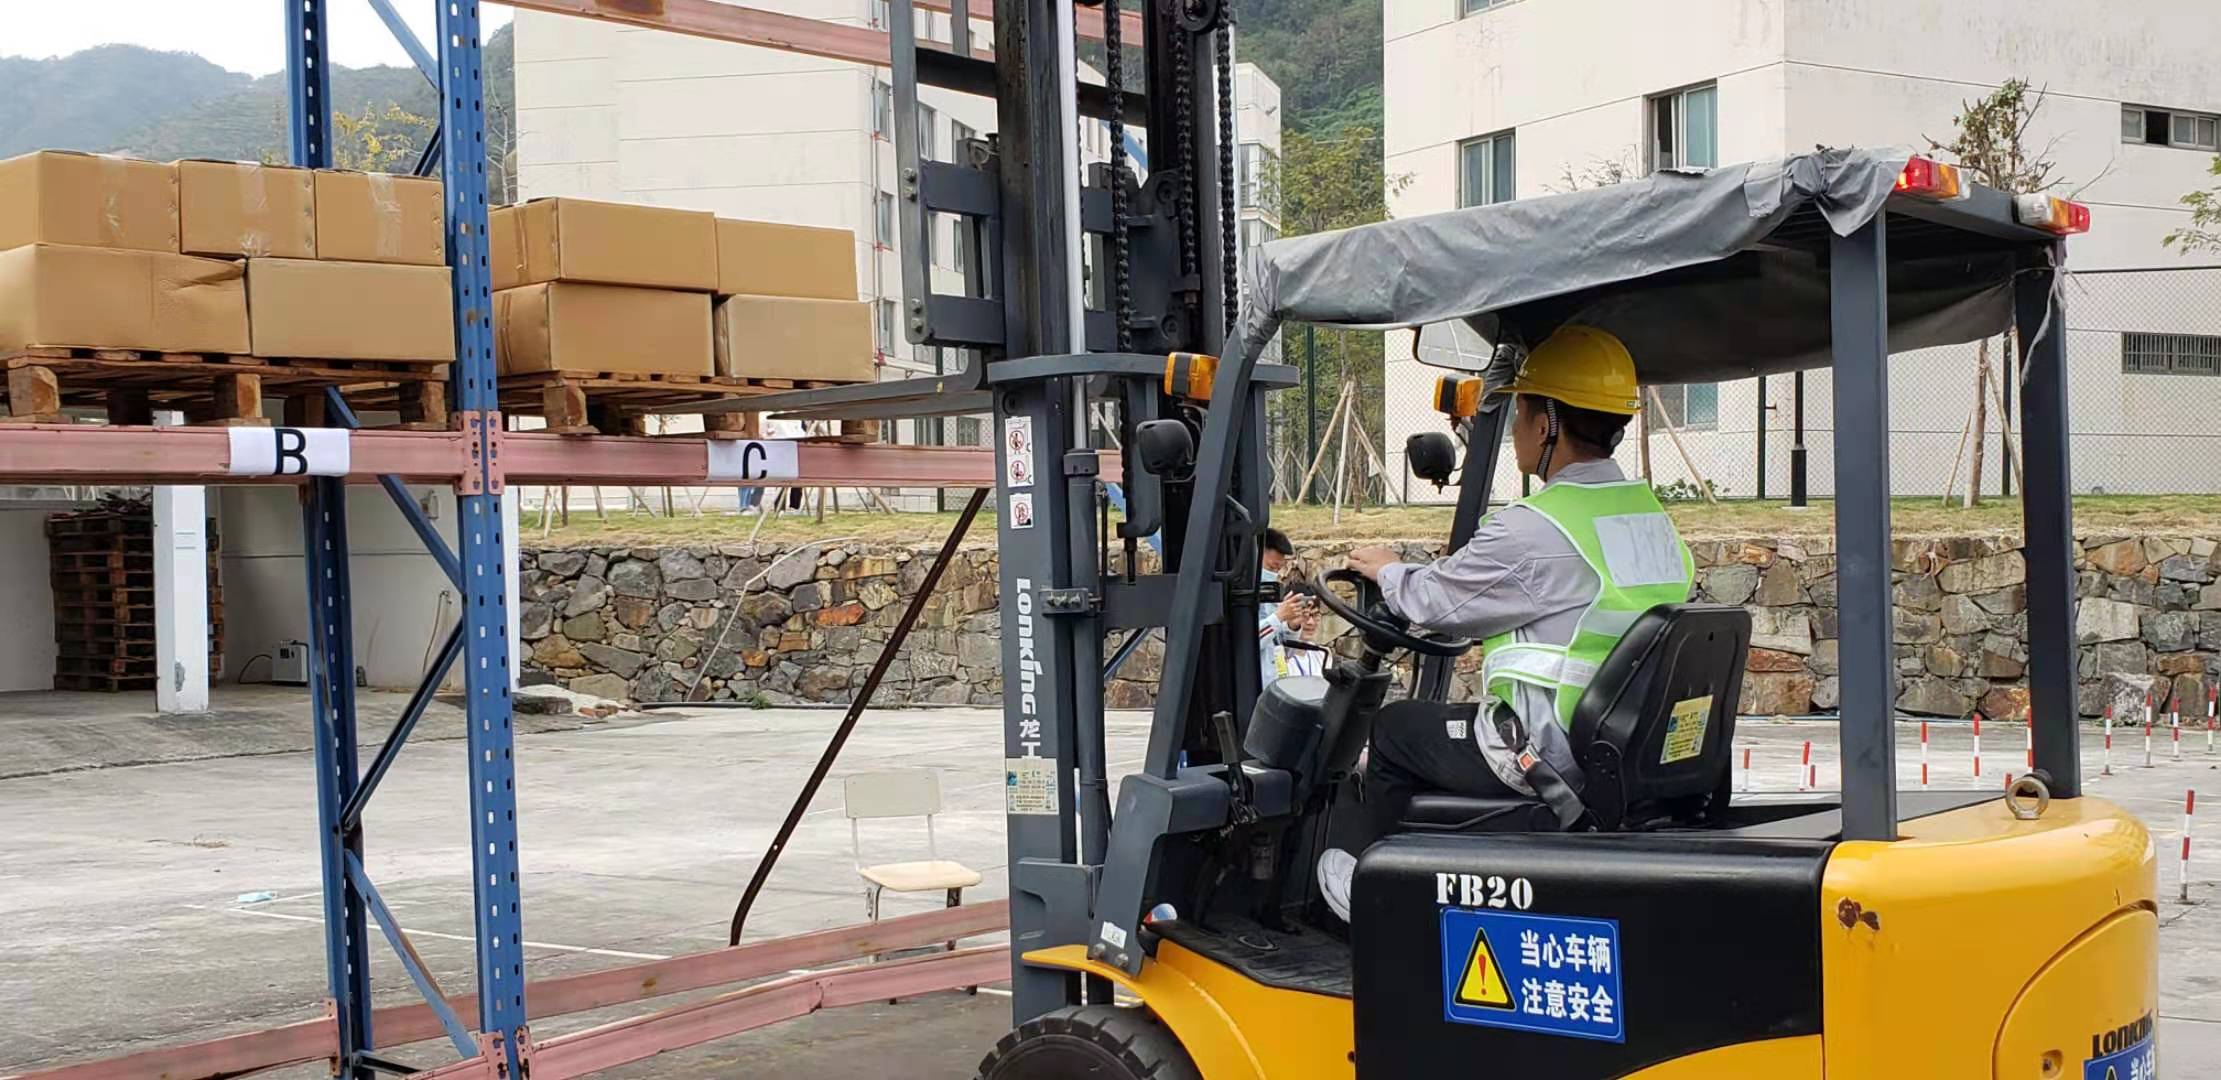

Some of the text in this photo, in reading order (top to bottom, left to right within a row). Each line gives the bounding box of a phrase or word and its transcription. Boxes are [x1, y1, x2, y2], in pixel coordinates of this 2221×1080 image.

[274, 428, 308, 475] B
[742, 442, 767, 479] C
[1019, 719, 1043, 759] 龙工
[1436, 873, 1533, 910] FB20
[1520, 929, 1611, 974] 当心车辆
[1521, 977, 1613, 1024] 注意安全
